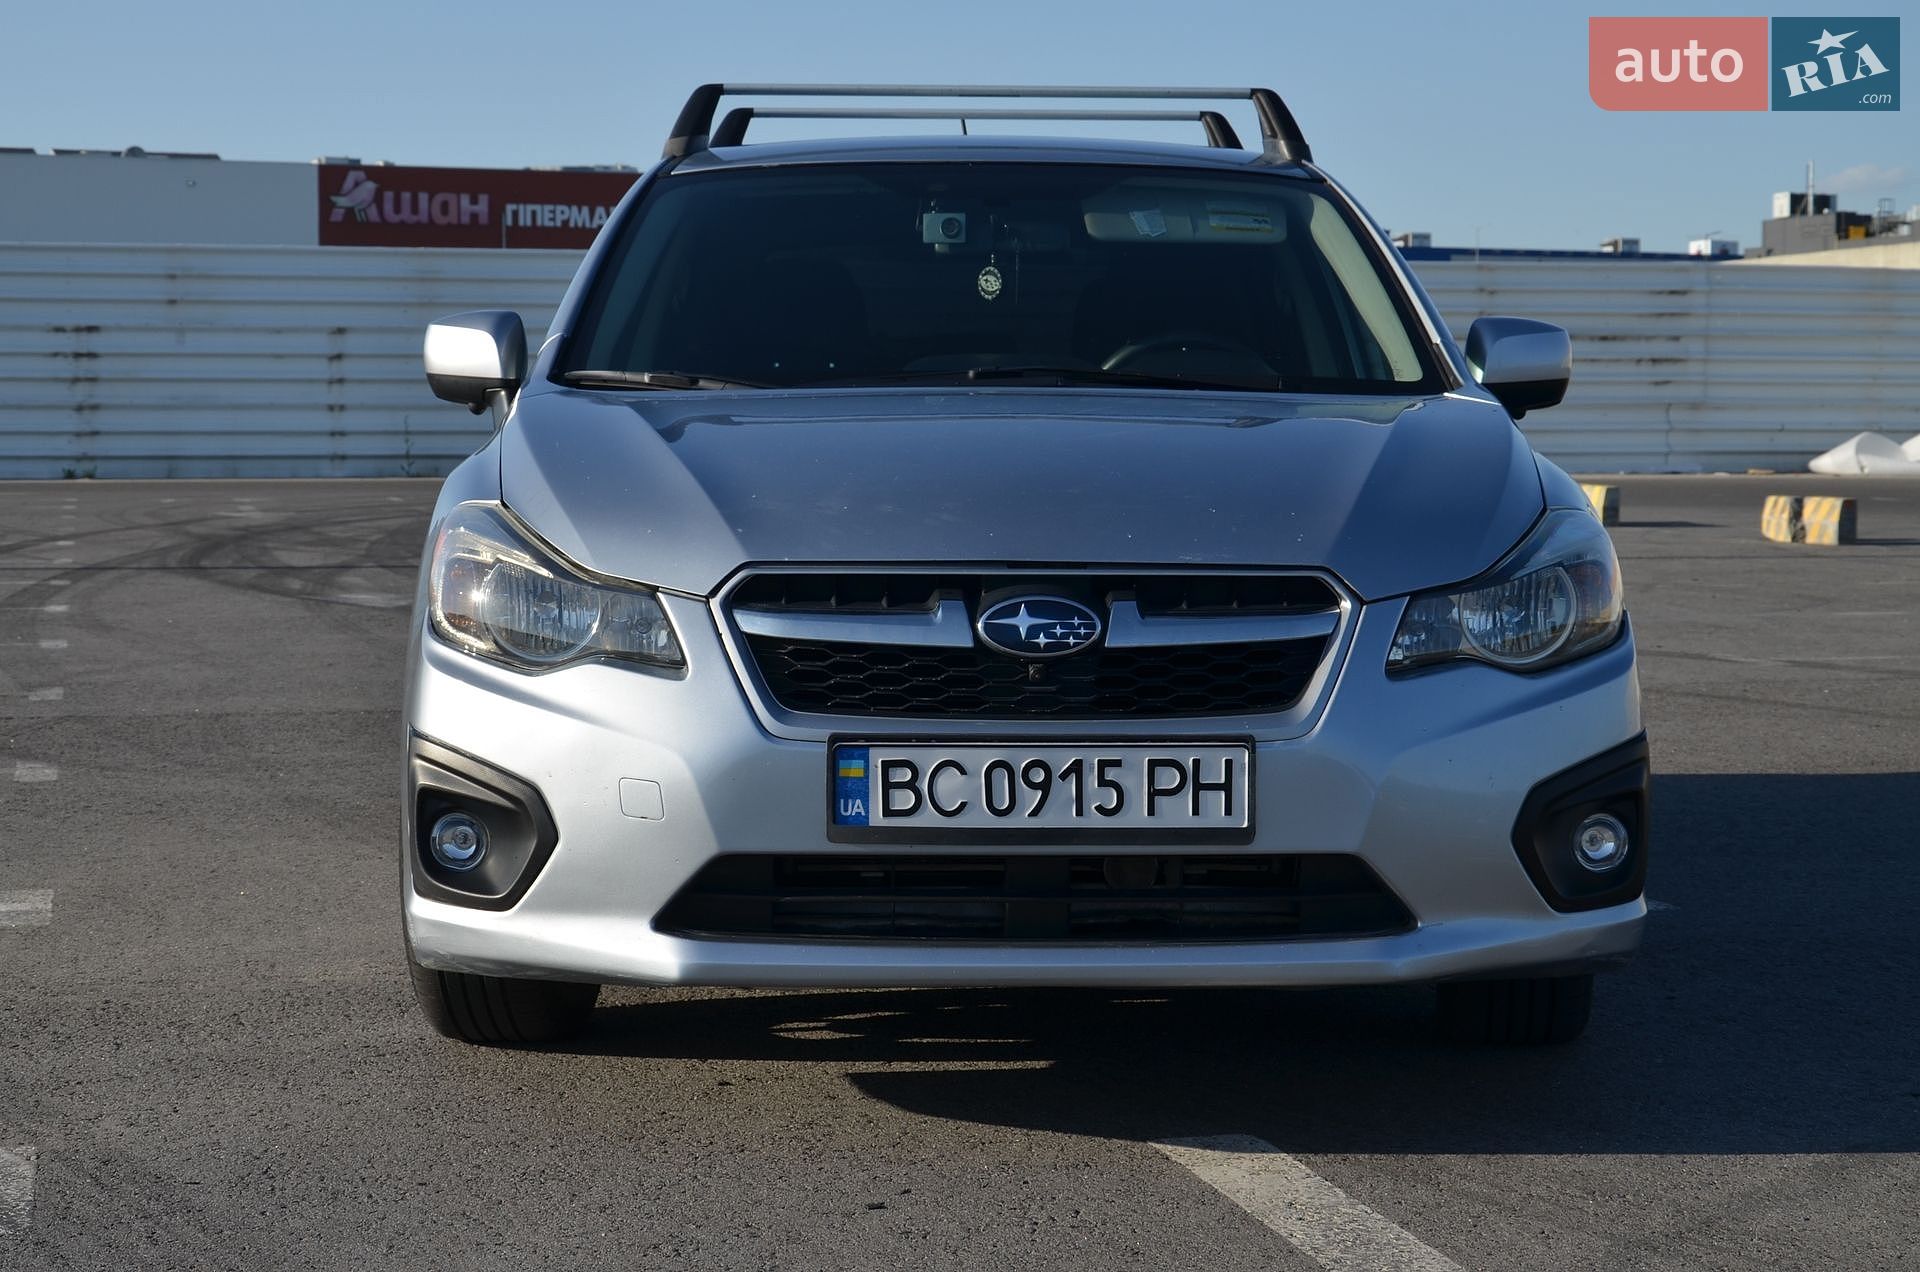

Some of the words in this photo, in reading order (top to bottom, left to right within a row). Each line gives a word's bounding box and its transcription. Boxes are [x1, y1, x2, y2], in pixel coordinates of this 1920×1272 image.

[504, 203, 617, 228] ГІПЕРМА
[880, 758, 969, 818] BC
[983, 758, 1125, 818] 0915
[1147, 757, 1234, 817] PH
[840, 799, 866, 816] UA
